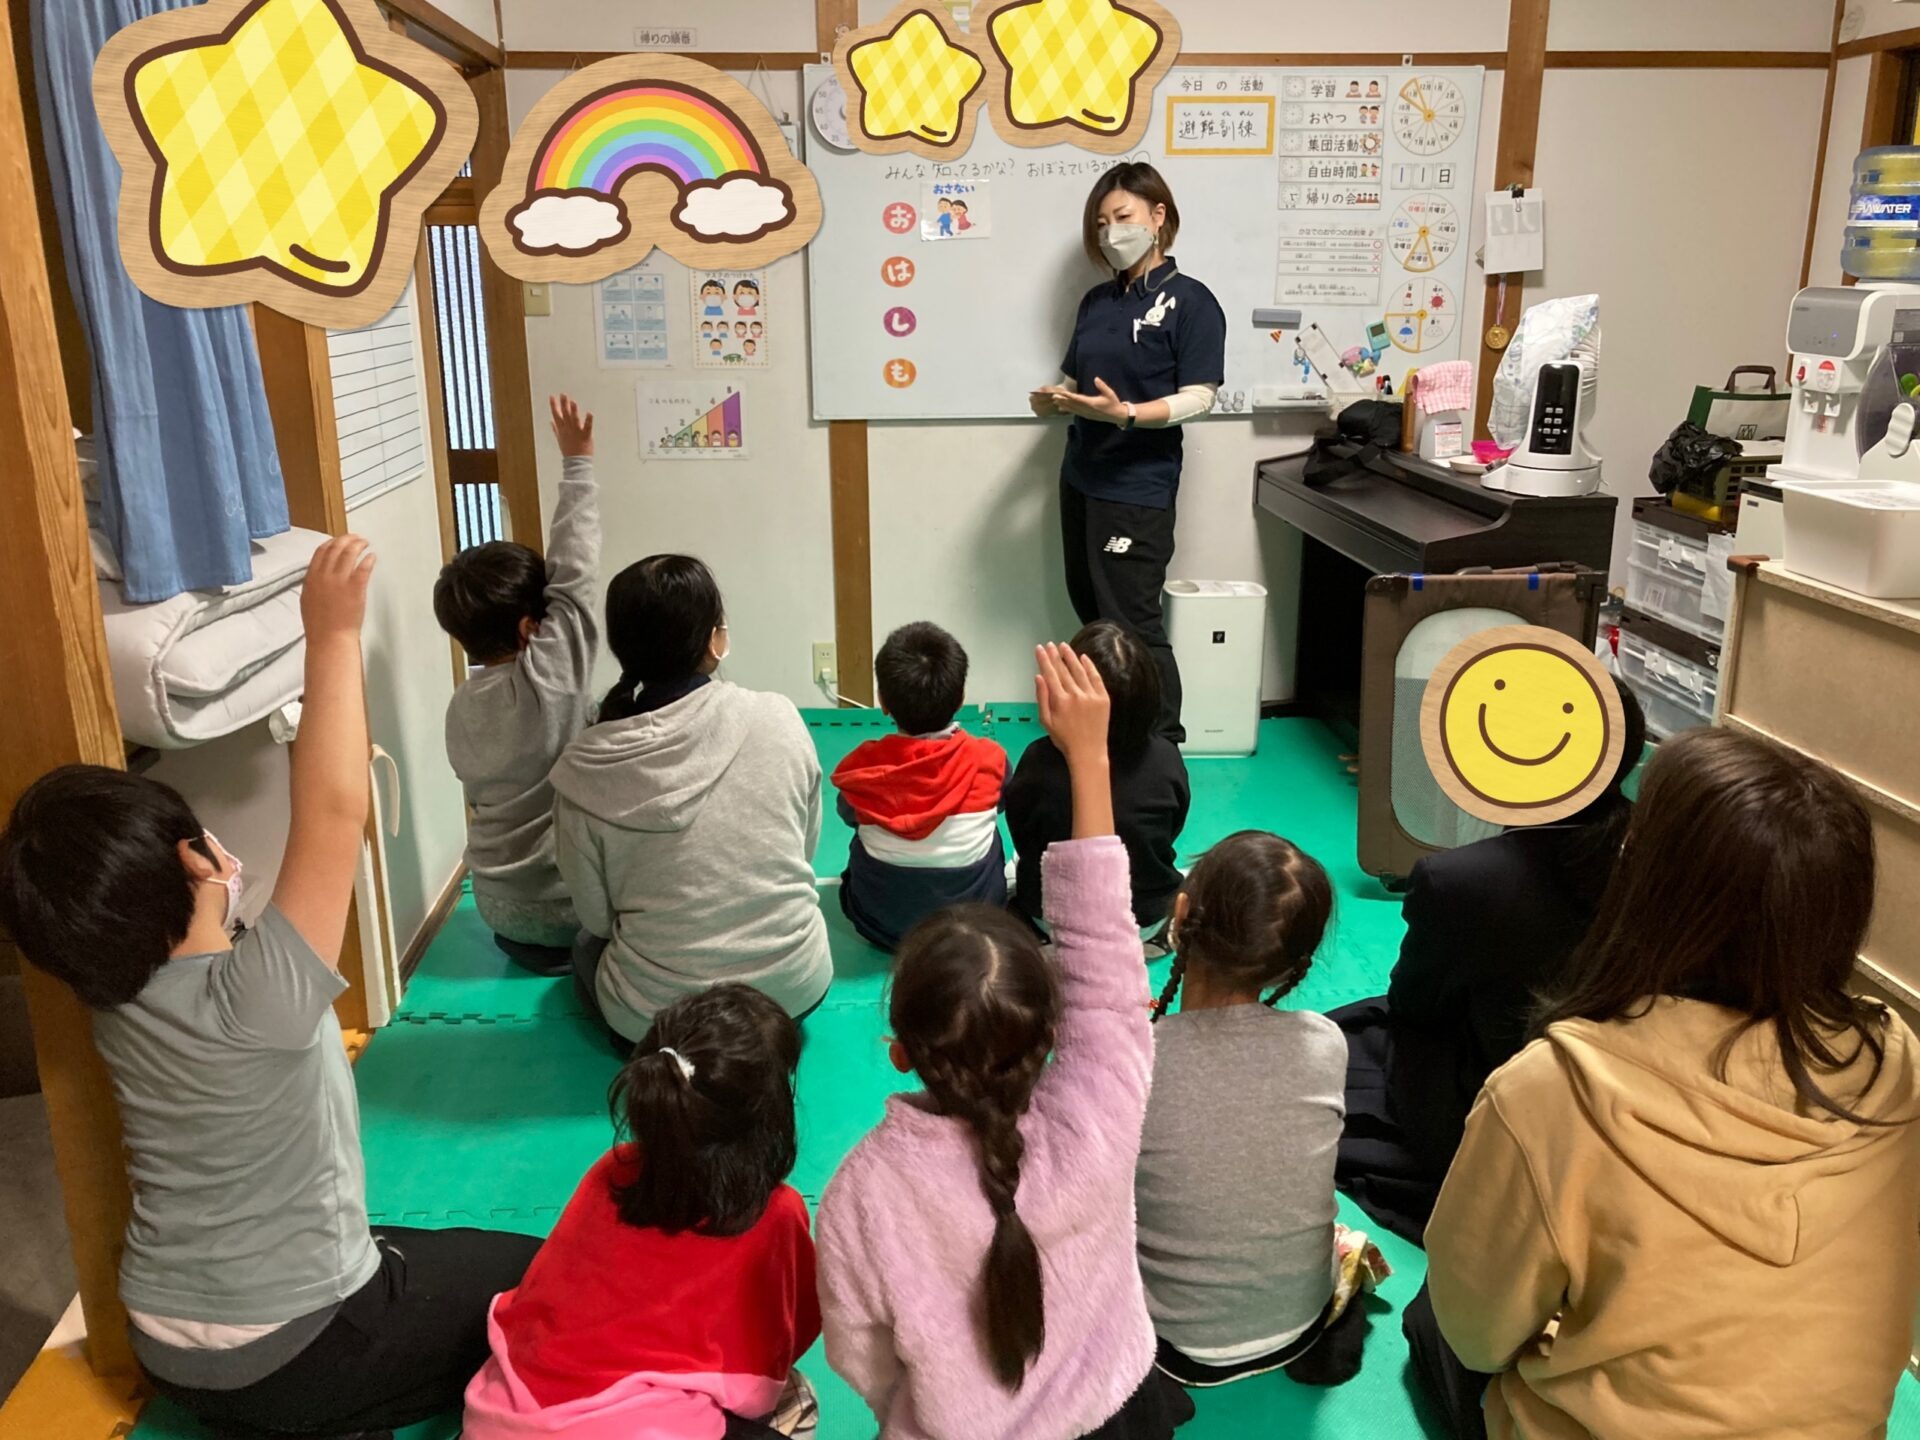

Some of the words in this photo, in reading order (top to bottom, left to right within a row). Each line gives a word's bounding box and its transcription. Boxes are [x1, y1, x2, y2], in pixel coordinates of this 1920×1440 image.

[1181, 79, 1203, 91] 今日
[1216, 80, 1228, 91] の
[1240, 79, 1264, 92] 活動
[1311, 84, 1336, 98] 学習
[1309, 112, 1347, 125] おやつ
[1179, 119, 1257, 142] 避難訓練
[1308, 139, 1359, 152] 集団活動
[884, 164, 926, 180] みんな
[1308, 165, 1358, 178] 自由時間
[933, 183, 975, 195] おさない
[1306, 192, 1357, 205] 帰りの会
[890, 205, 912, 229] お
[887, 260, 912, 282] は
[892, 312, 910, 332] し
[890, 363, 909, 382] も
